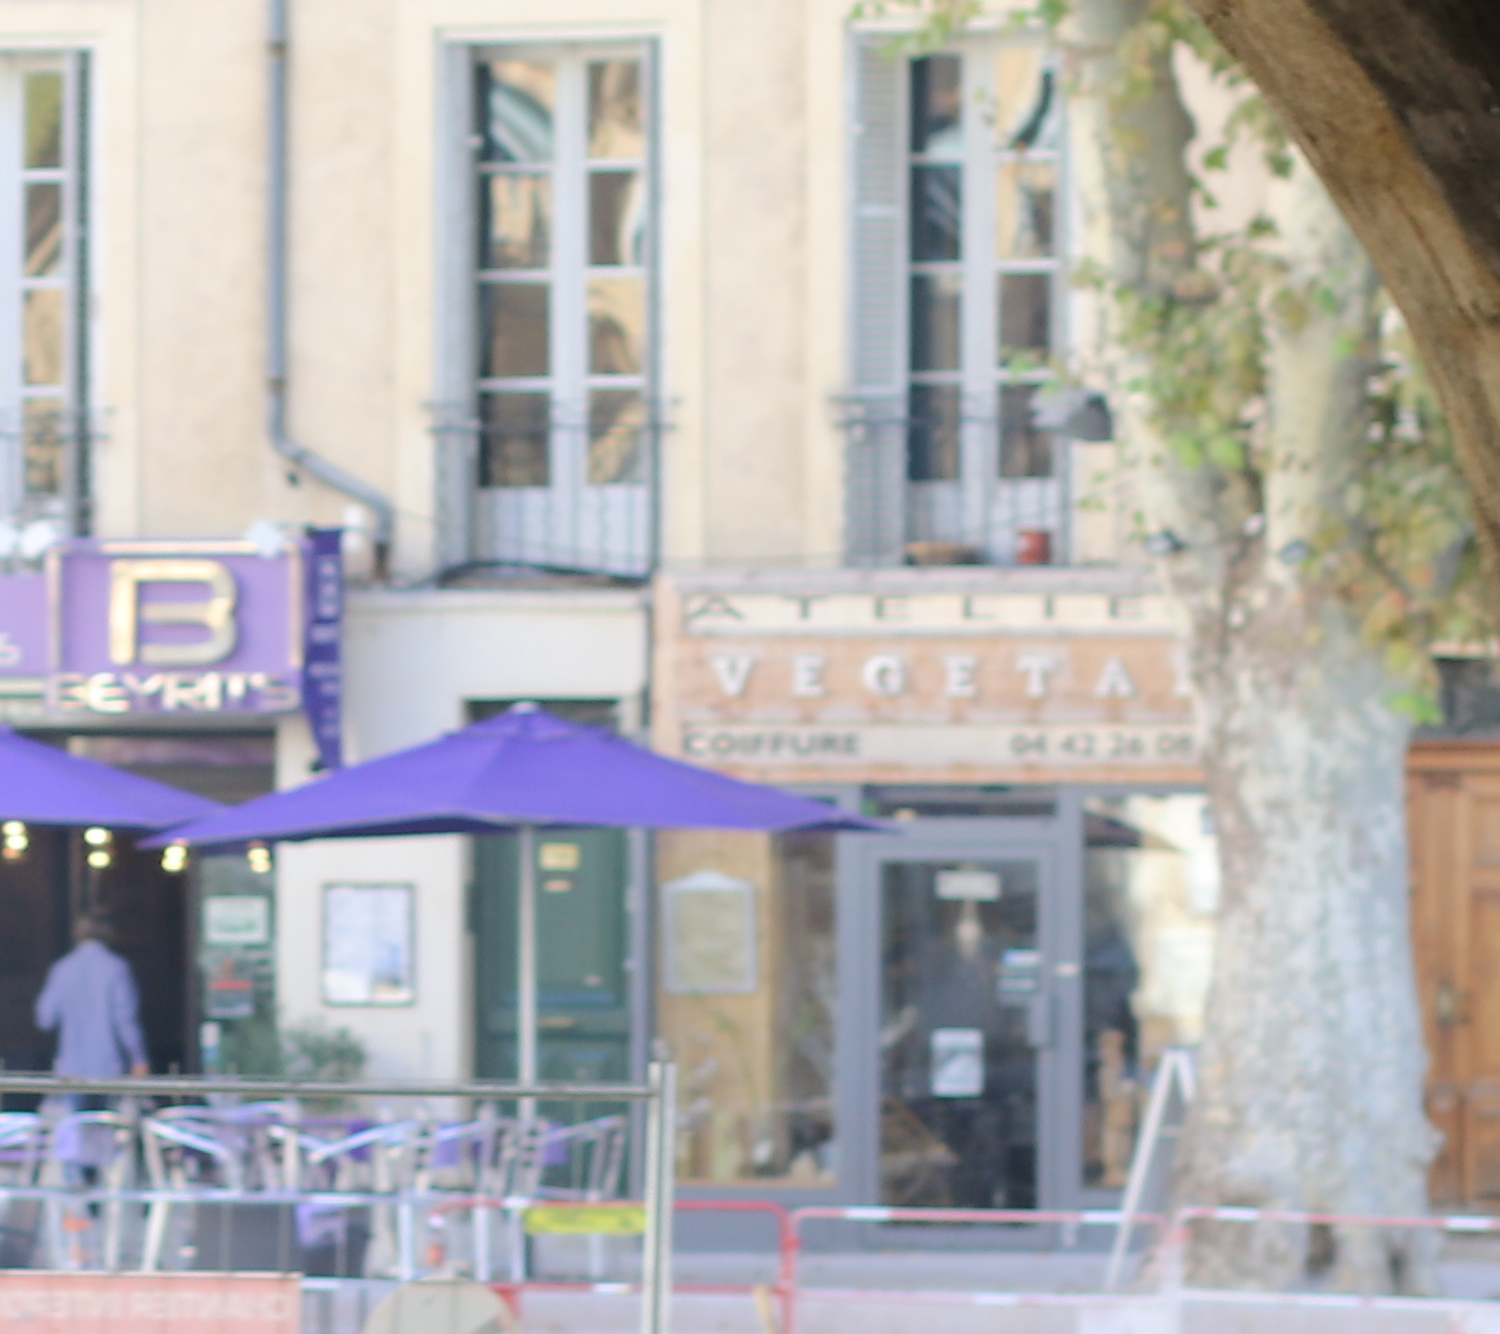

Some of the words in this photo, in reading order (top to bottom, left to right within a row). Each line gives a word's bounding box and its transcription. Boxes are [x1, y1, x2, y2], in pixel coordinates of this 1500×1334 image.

[686, 594, 1150, 621] ATELIE
[682, 732, 861, 757] COIFFURE
[1009, 732, 1048, 757] 04
[1059, 732, 1097, 757] 42
